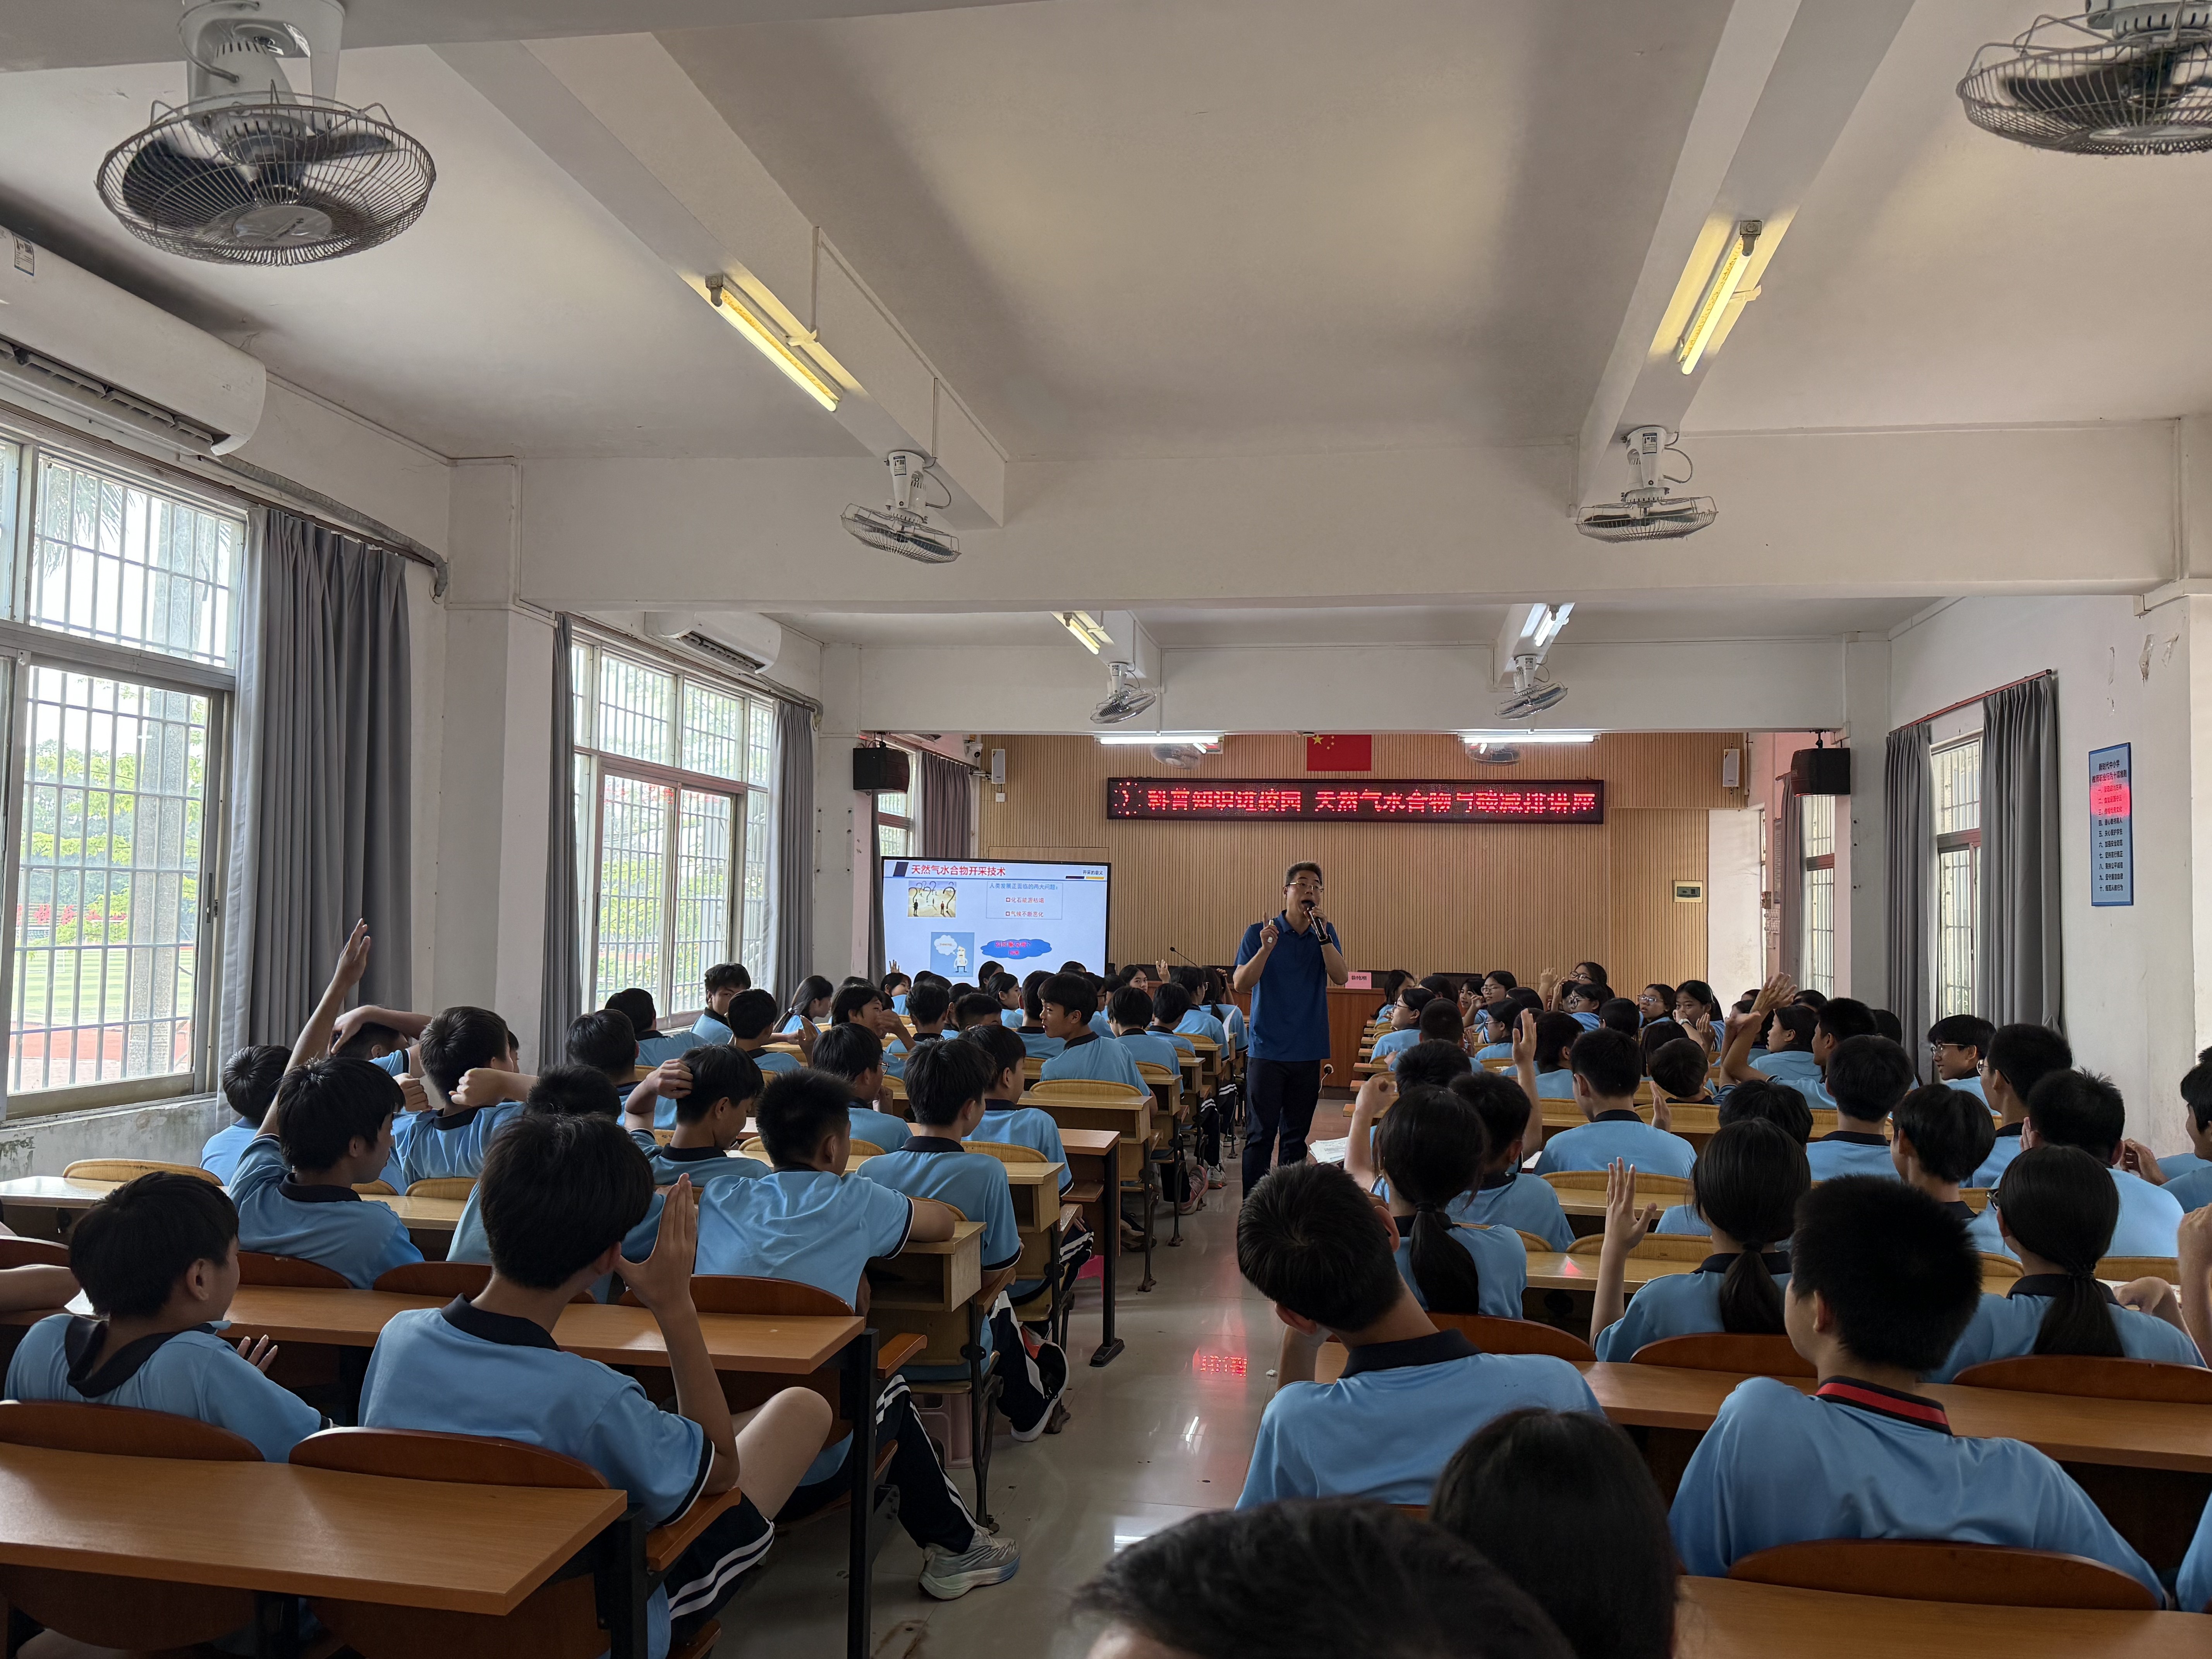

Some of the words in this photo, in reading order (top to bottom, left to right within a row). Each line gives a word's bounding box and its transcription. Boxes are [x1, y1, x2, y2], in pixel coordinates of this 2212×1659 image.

[2099, 759, 2120, 771] 新时代中小学
[911, 865, 1006, 876] 天然气水合物开采技术
